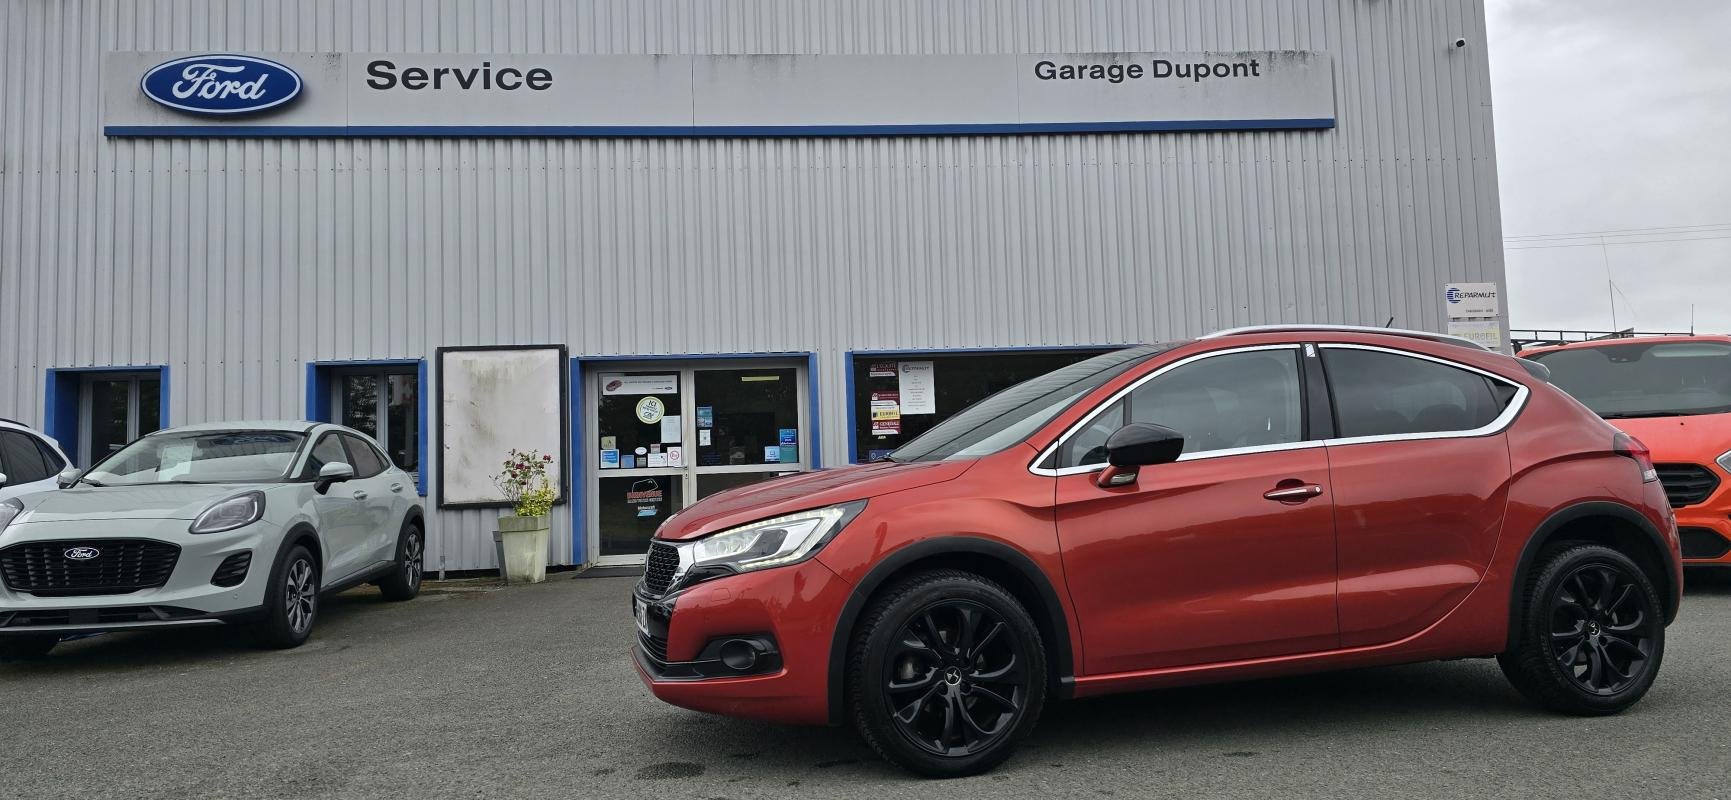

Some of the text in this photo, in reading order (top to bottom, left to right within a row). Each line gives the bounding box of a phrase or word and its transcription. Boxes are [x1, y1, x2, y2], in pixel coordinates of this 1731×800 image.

[172, 63, 268, 100] Ford
[365, 60, 554, 91] Service
[1034, 59, 1260, 84] Garage Dupont
[71, 549, 93, 558] Ford
